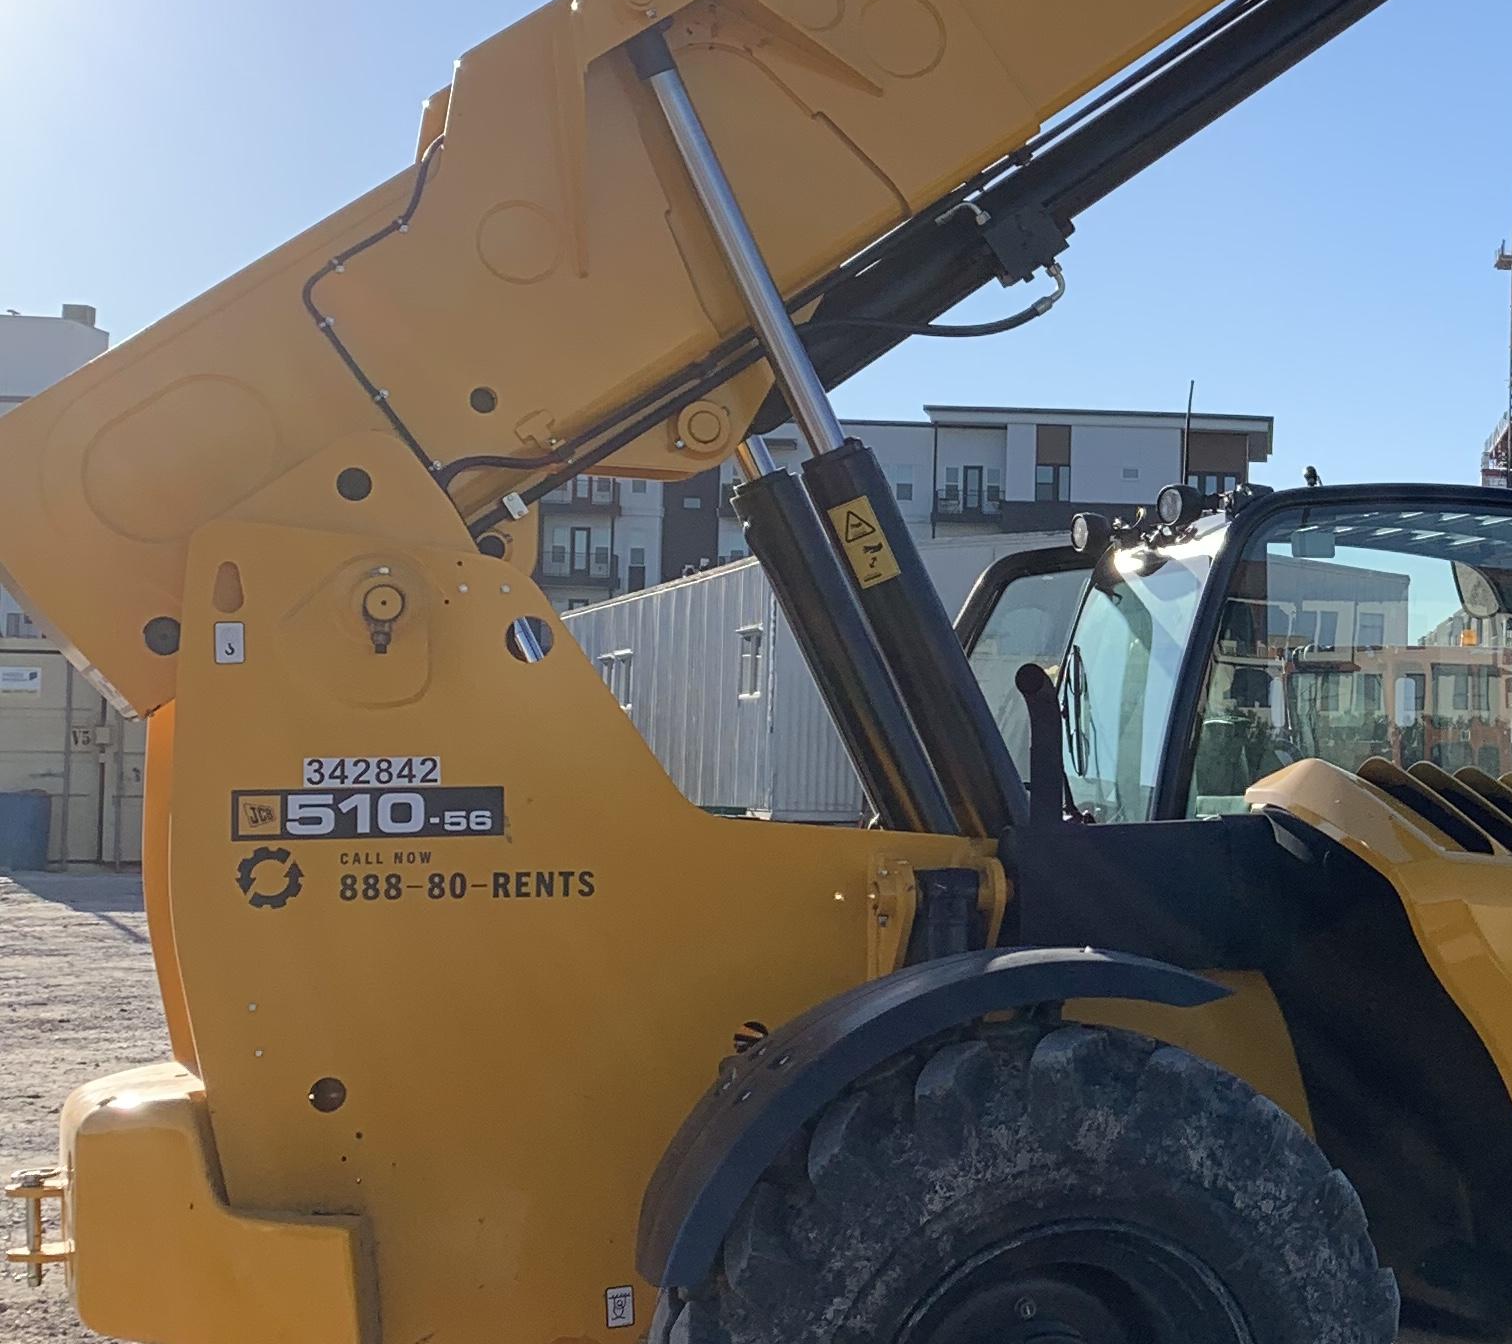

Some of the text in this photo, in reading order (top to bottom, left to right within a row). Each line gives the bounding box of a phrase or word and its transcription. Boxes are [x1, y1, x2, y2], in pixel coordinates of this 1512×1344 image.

[305, 757, 439, 786] 342842
[249, 806, 275, 825] JCB
[285, 792, 493, 836] 510-56
[340, 851, 433, 866] CALL NOW
[339, 870, 596, 902] 888-80-RENTS
